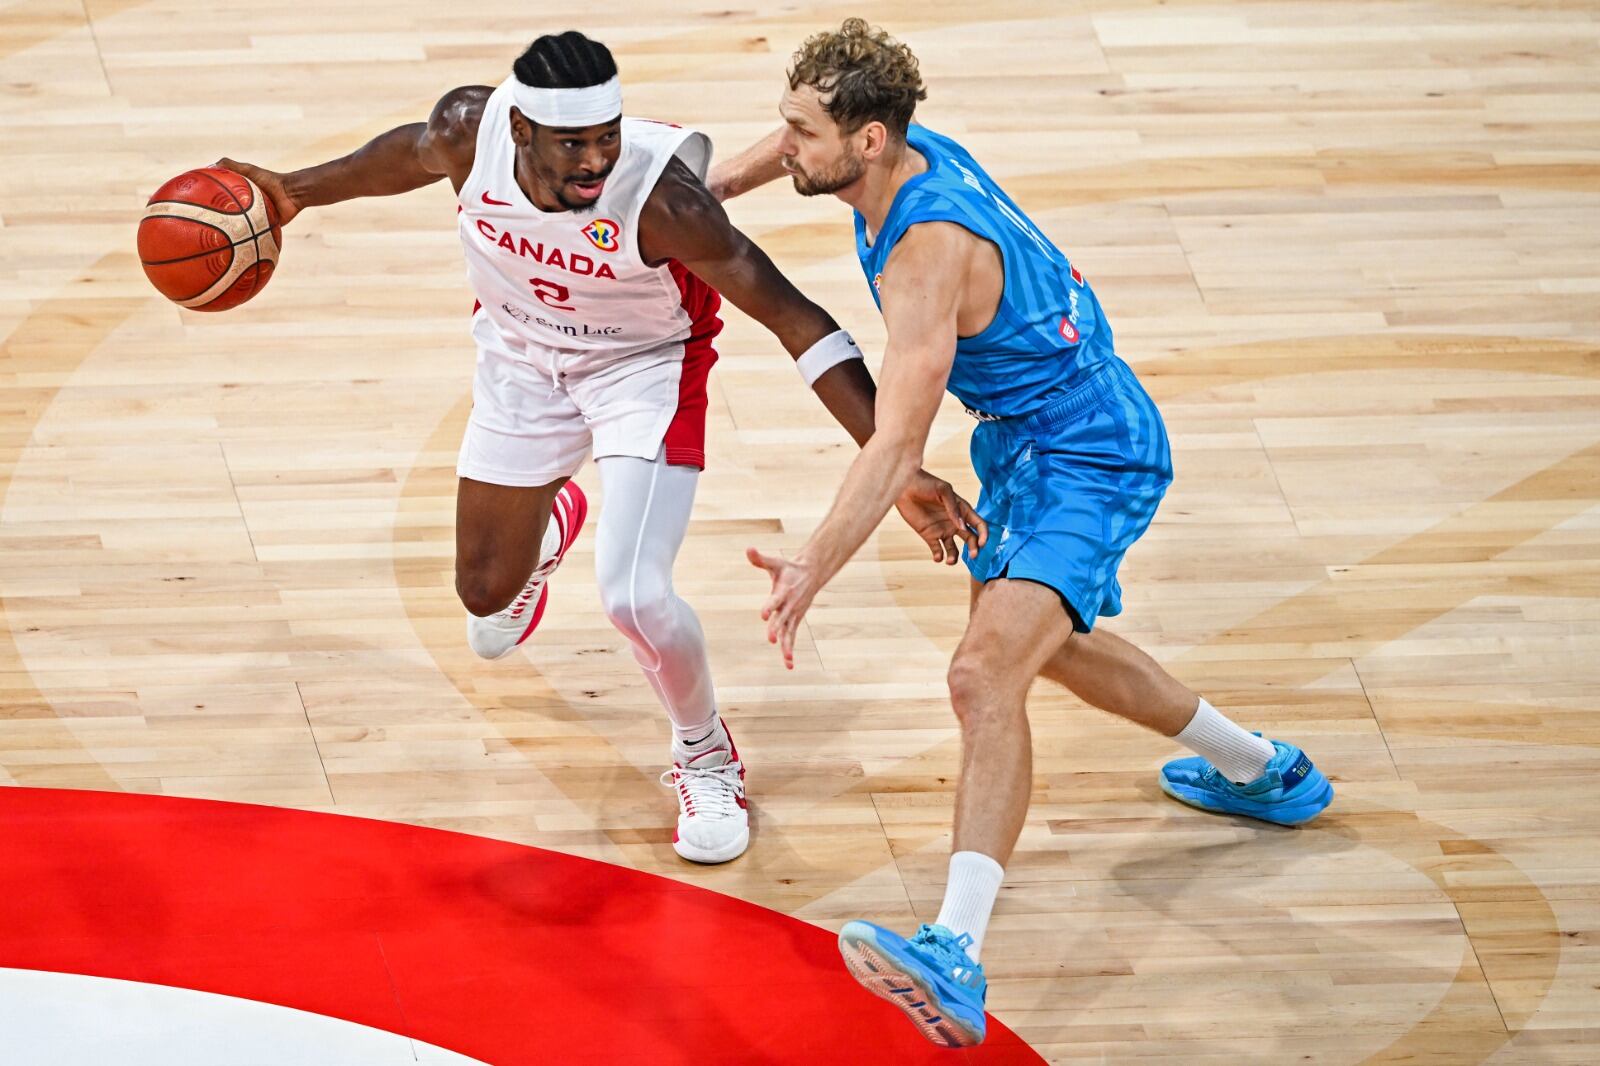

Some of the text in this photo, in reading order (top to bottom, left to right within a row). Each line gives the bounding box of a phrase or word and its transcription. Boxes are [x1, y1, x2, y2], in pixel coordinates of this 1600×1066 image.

[476, 219, 617, 280] CANADA
[529, 277, 576, 311] 2
[535, 317, 622, 336] Sun Life
